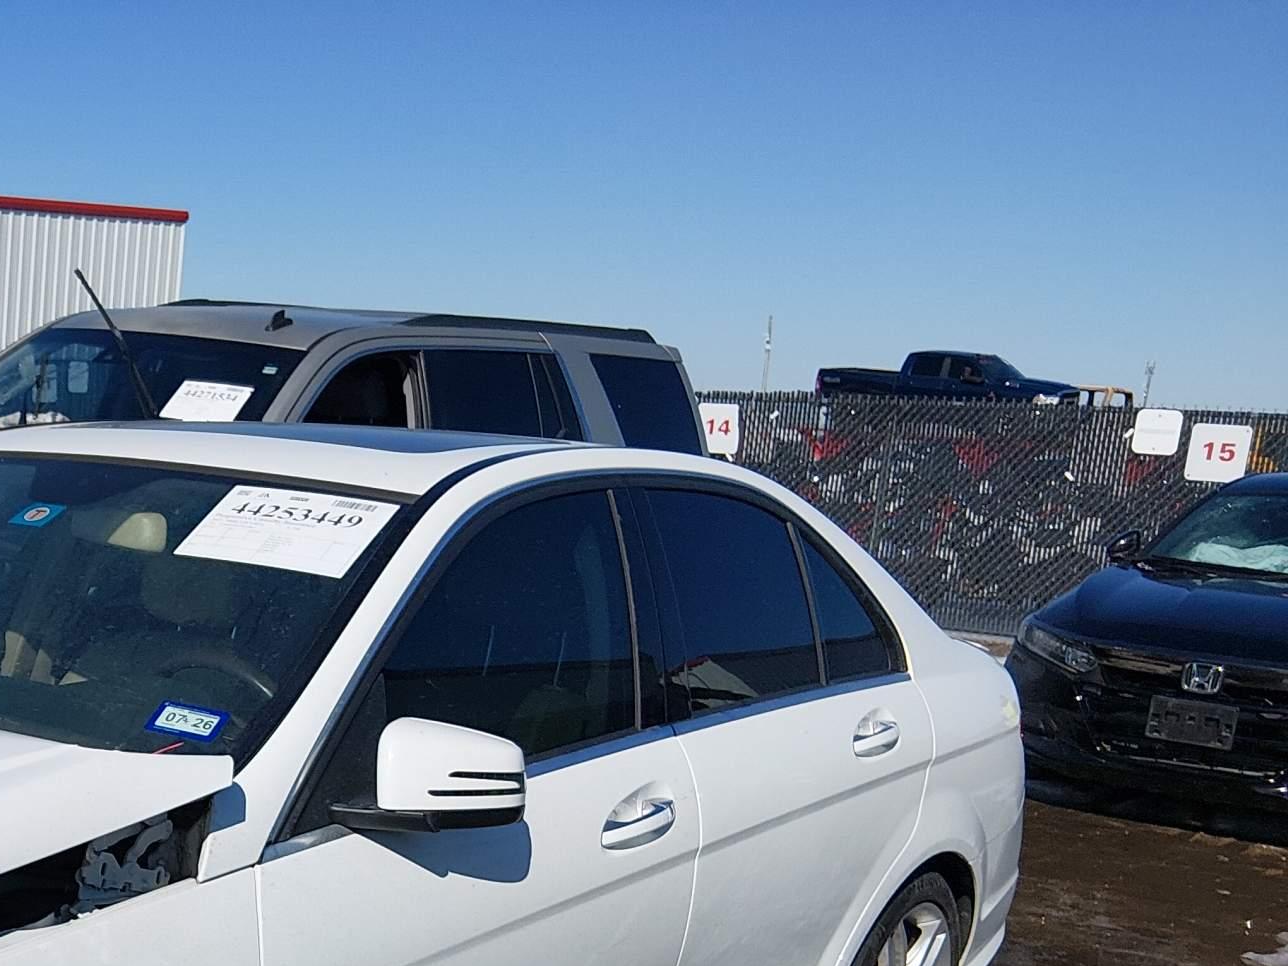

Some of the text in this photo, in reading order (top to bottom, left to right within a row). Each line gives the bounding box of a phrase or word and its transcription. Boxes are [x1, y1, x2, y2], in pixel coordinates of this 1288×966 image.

[706, 418, 731, 436] 14
[1203, 442, 1237, 462] 15
[231, 501, 364, 528] 44253449
[165, 712, 186, 724] 07
[192, 718, 214, 731] 26
